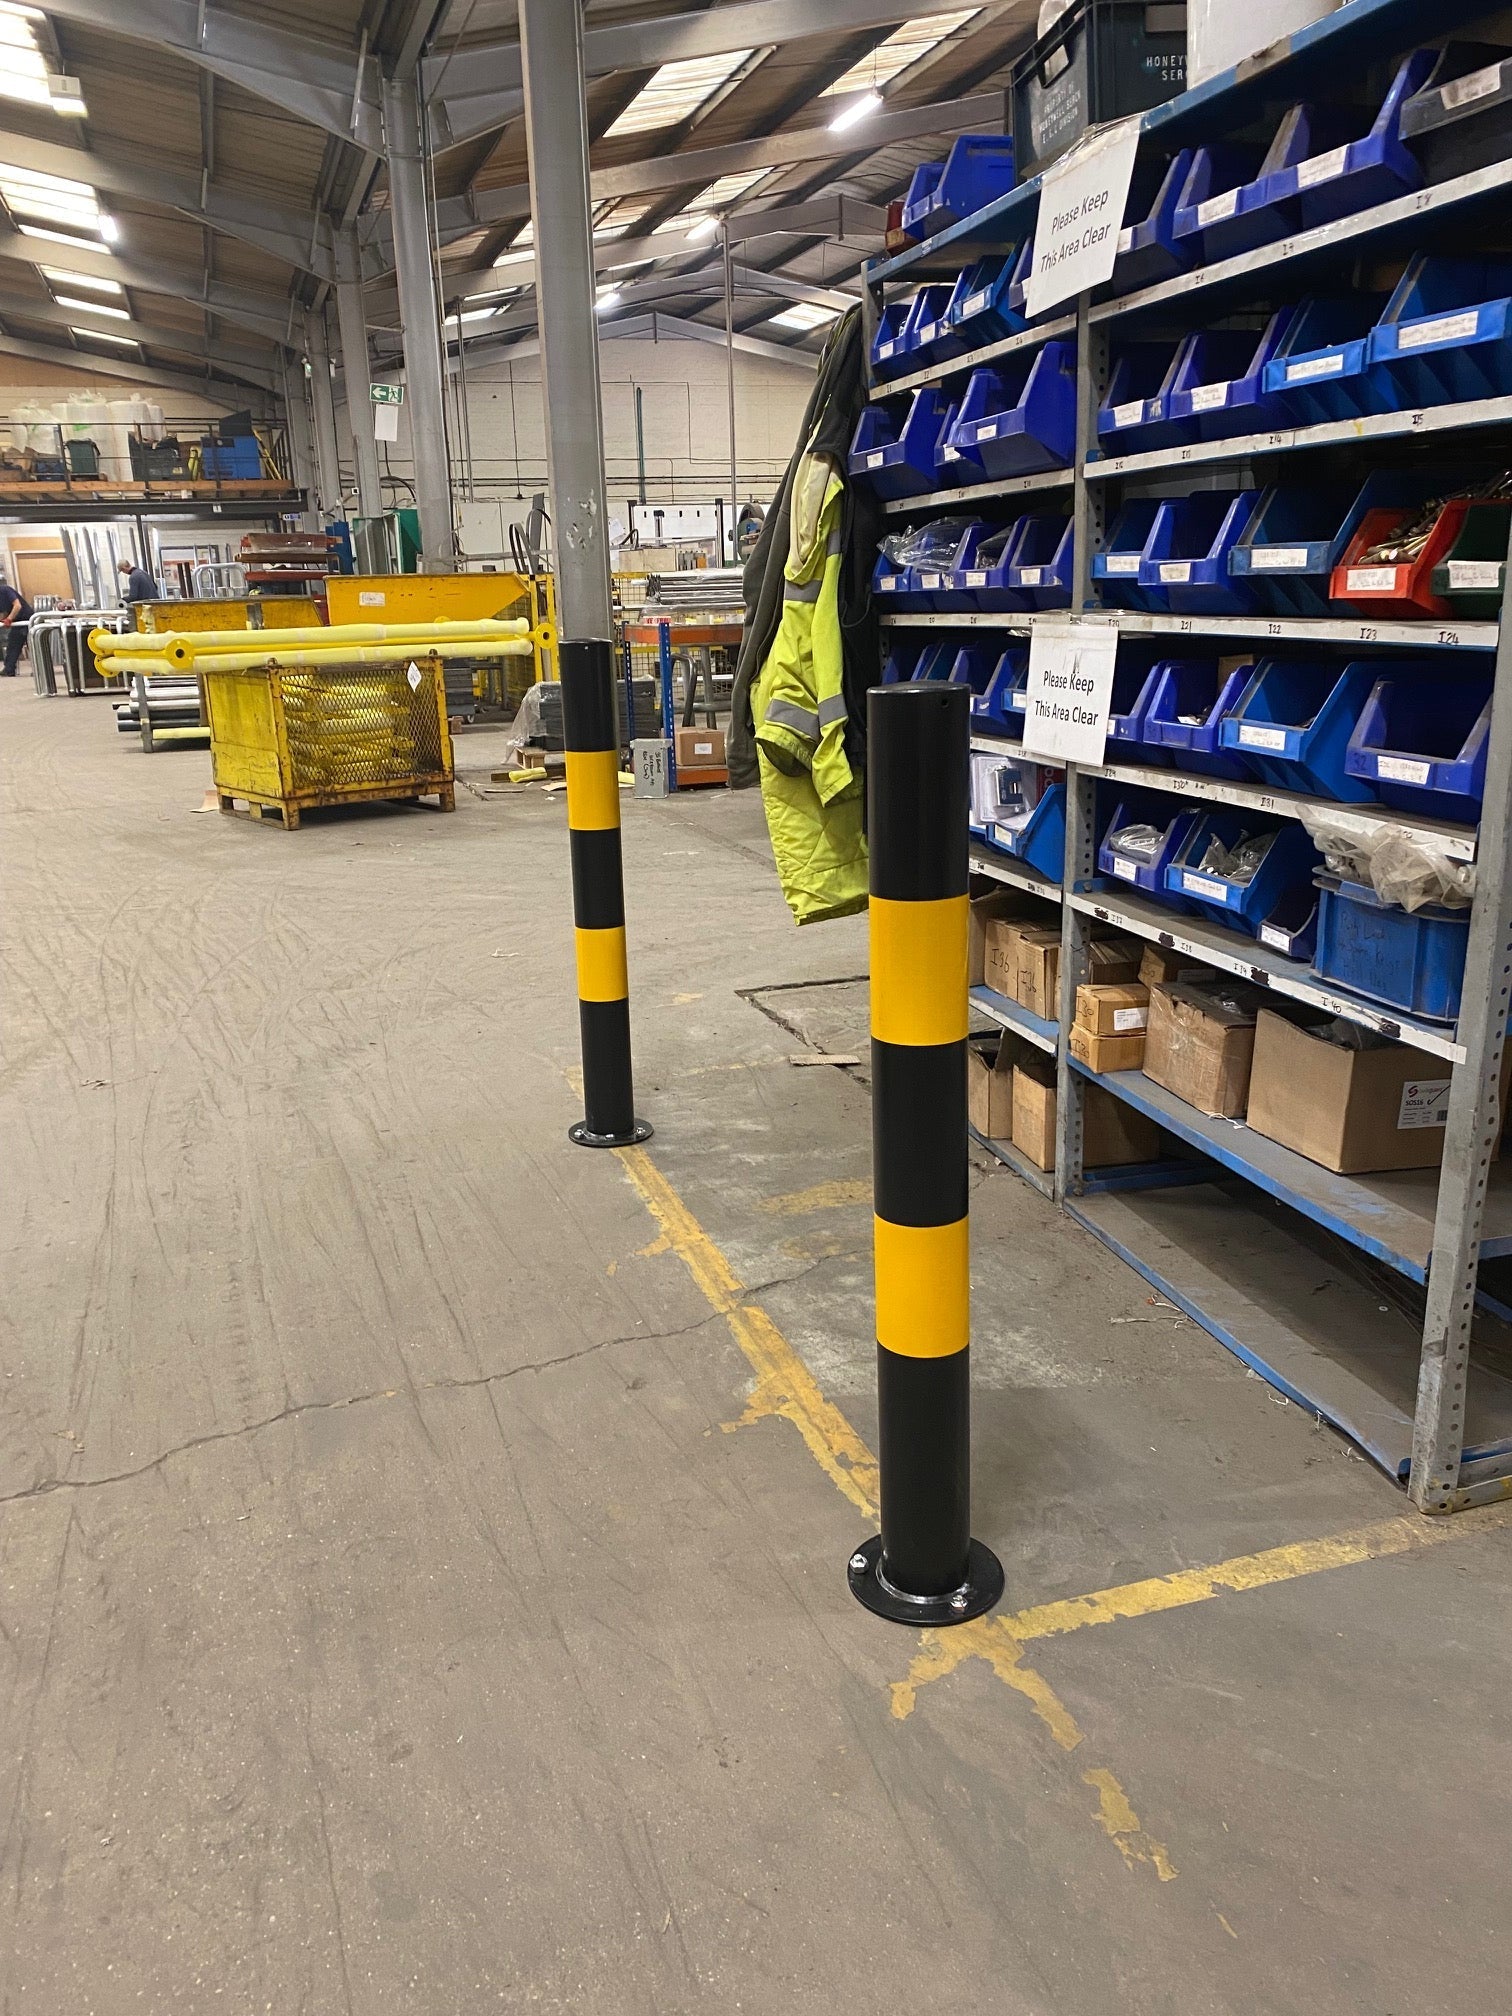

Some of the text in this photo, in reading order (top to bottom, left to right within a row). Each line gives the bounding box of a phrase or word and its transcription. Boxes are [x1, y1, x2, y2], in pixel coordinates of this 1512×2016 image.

[1146, 55, 1187, 67] HONEY
[1161, 69, 1187, 81] SER
[1052, 190, 1109, 235] Please Keep
[1040, 223, 1111, 272] This Area Clear
[1359, 627, 1377, 641] I23
[1437, 631, 1460, 645] I24
[1043, 670, 1094, 696] Please Keep
[1035, 700, 1099, 726] This Area Clear
[989, 948, 1010, 974] I36
